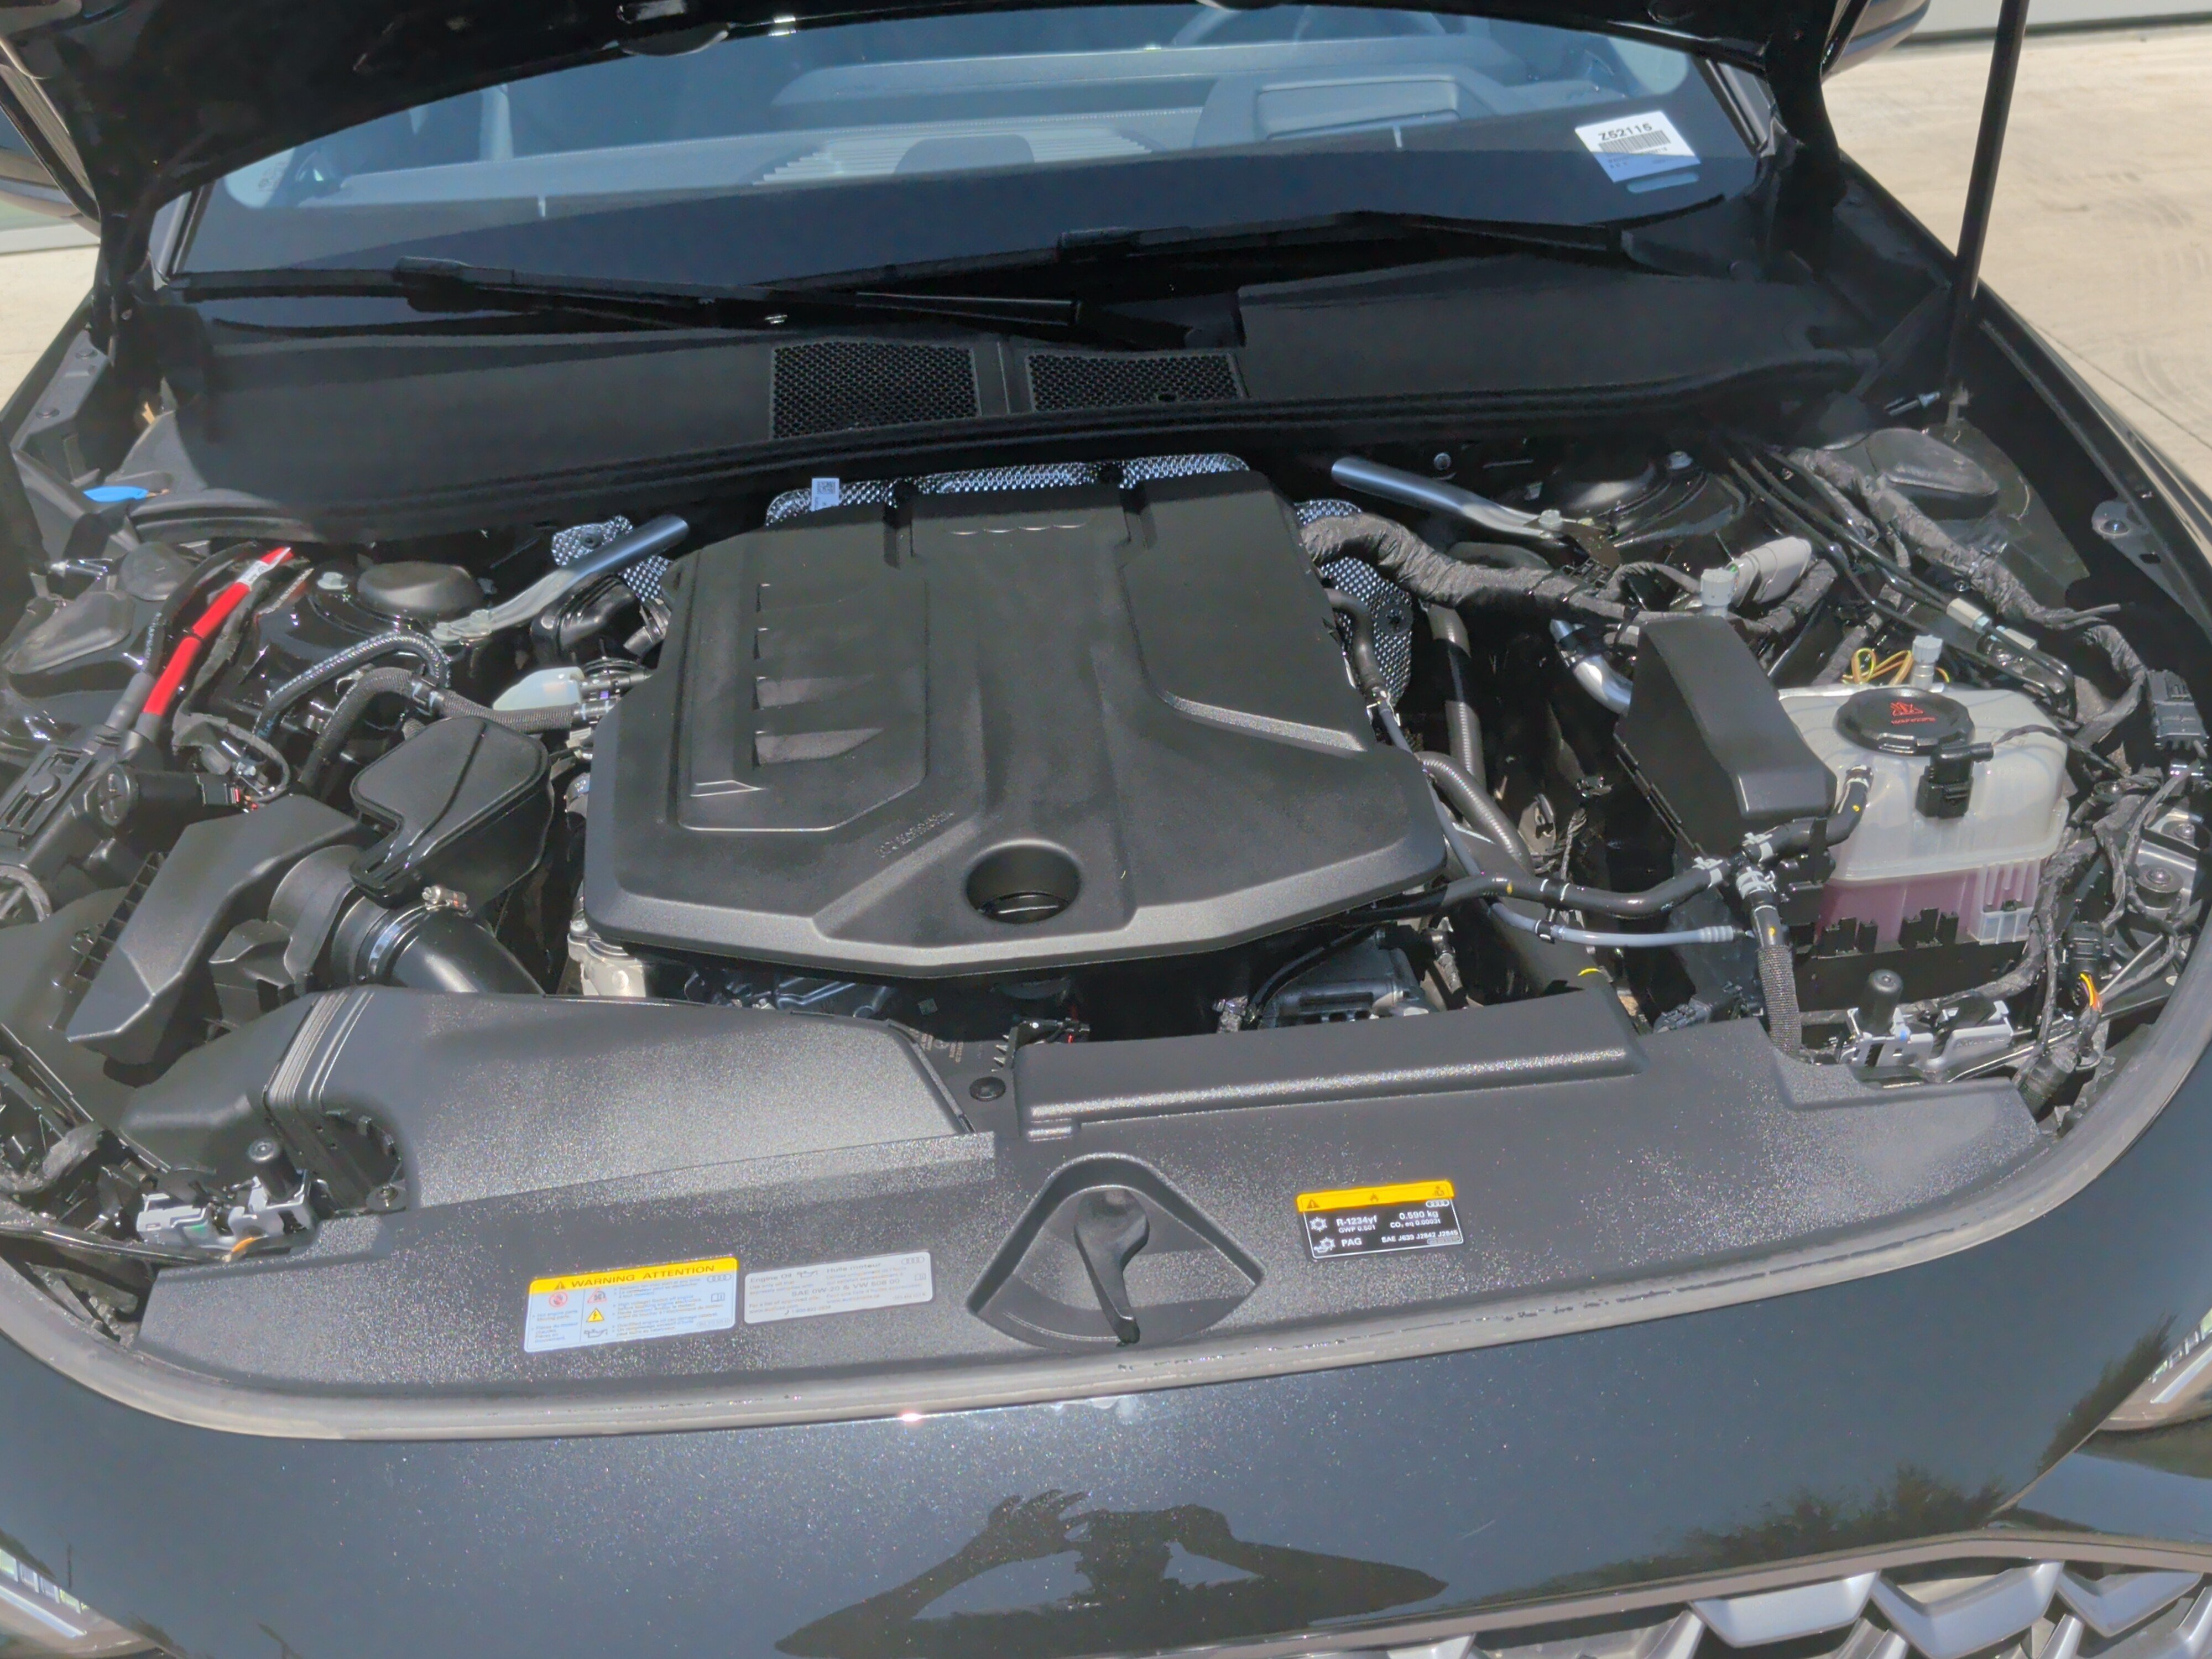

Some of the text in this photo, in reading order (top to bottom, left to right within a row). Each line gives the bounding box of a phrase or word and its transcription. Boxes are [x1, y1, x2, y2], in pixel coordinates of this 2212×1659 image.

[1426, 1210, 1439, 1218] kg
[1336, 1215, 1377, 1227] R-1234yf
[1341, 1238, 1363, 1247] PAG
[571, 1274, 635, 1288] WARNING
[642, 1265, 715, 1280] ATTENTION
[750, 1275, 778, 1283] Engine
